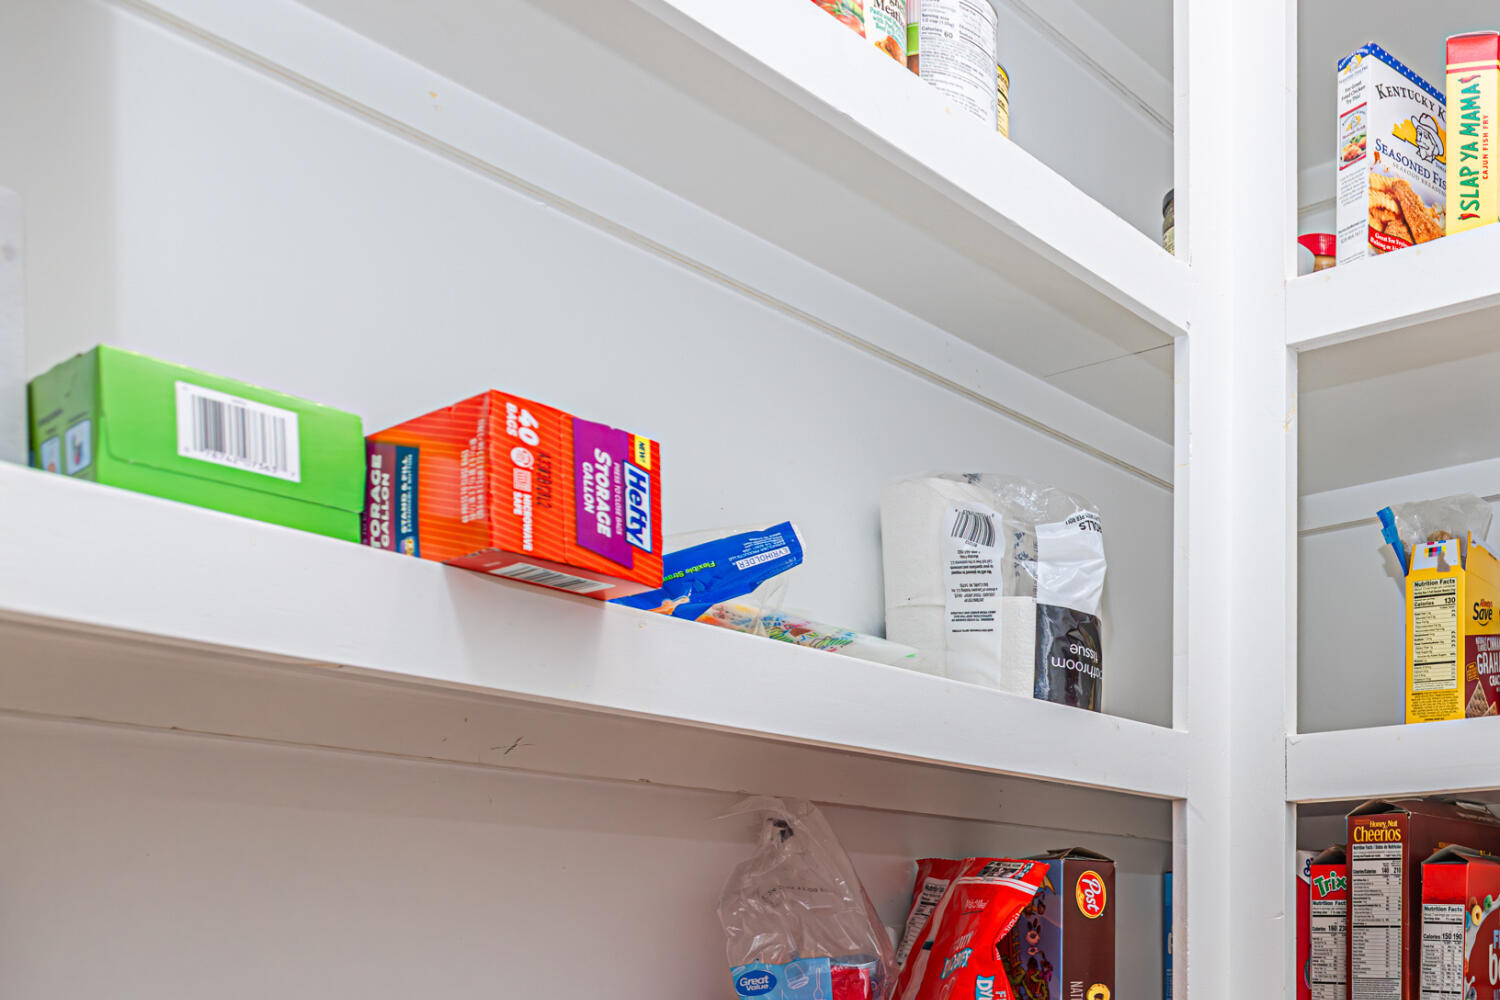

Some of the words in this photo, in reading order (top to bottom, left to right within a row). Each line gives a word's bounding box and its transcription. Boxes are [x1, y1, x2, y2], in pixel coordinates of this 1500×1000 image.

[1375, 83, 1435, 116] KENTUCKY
[1460, 83, 1481, 137] MAMA
[1460, 141, 1479, 162] YA
[1460, 166, 1481, 211] SLAP
[506, 402, 518, 437] BAGS
[517, 408, 540, 447] 40
[513, 491, 521, 516] SAFE
[582, 461, 595, 515] GALLON
[593, 447, 613, 539] STORAGE
[522, 494, 533, 551] MICROWAVE
[625, 466, 648, 547] Hefty
[1413, 579, 1438, 587] Nutrition
[1440, 577, 1456, 585] Facts
[1473, 602, 1493, 621] Save
[1354, 826, 1401, 843] Cheerios
[1370, 820, 1386, 829] Honey
[1080, 874, 1102, 913] Post
[1314, 871, 1347, 897] Trix
[739, 975, 769, 989] Great
[745, 982, 770, 991] Value
